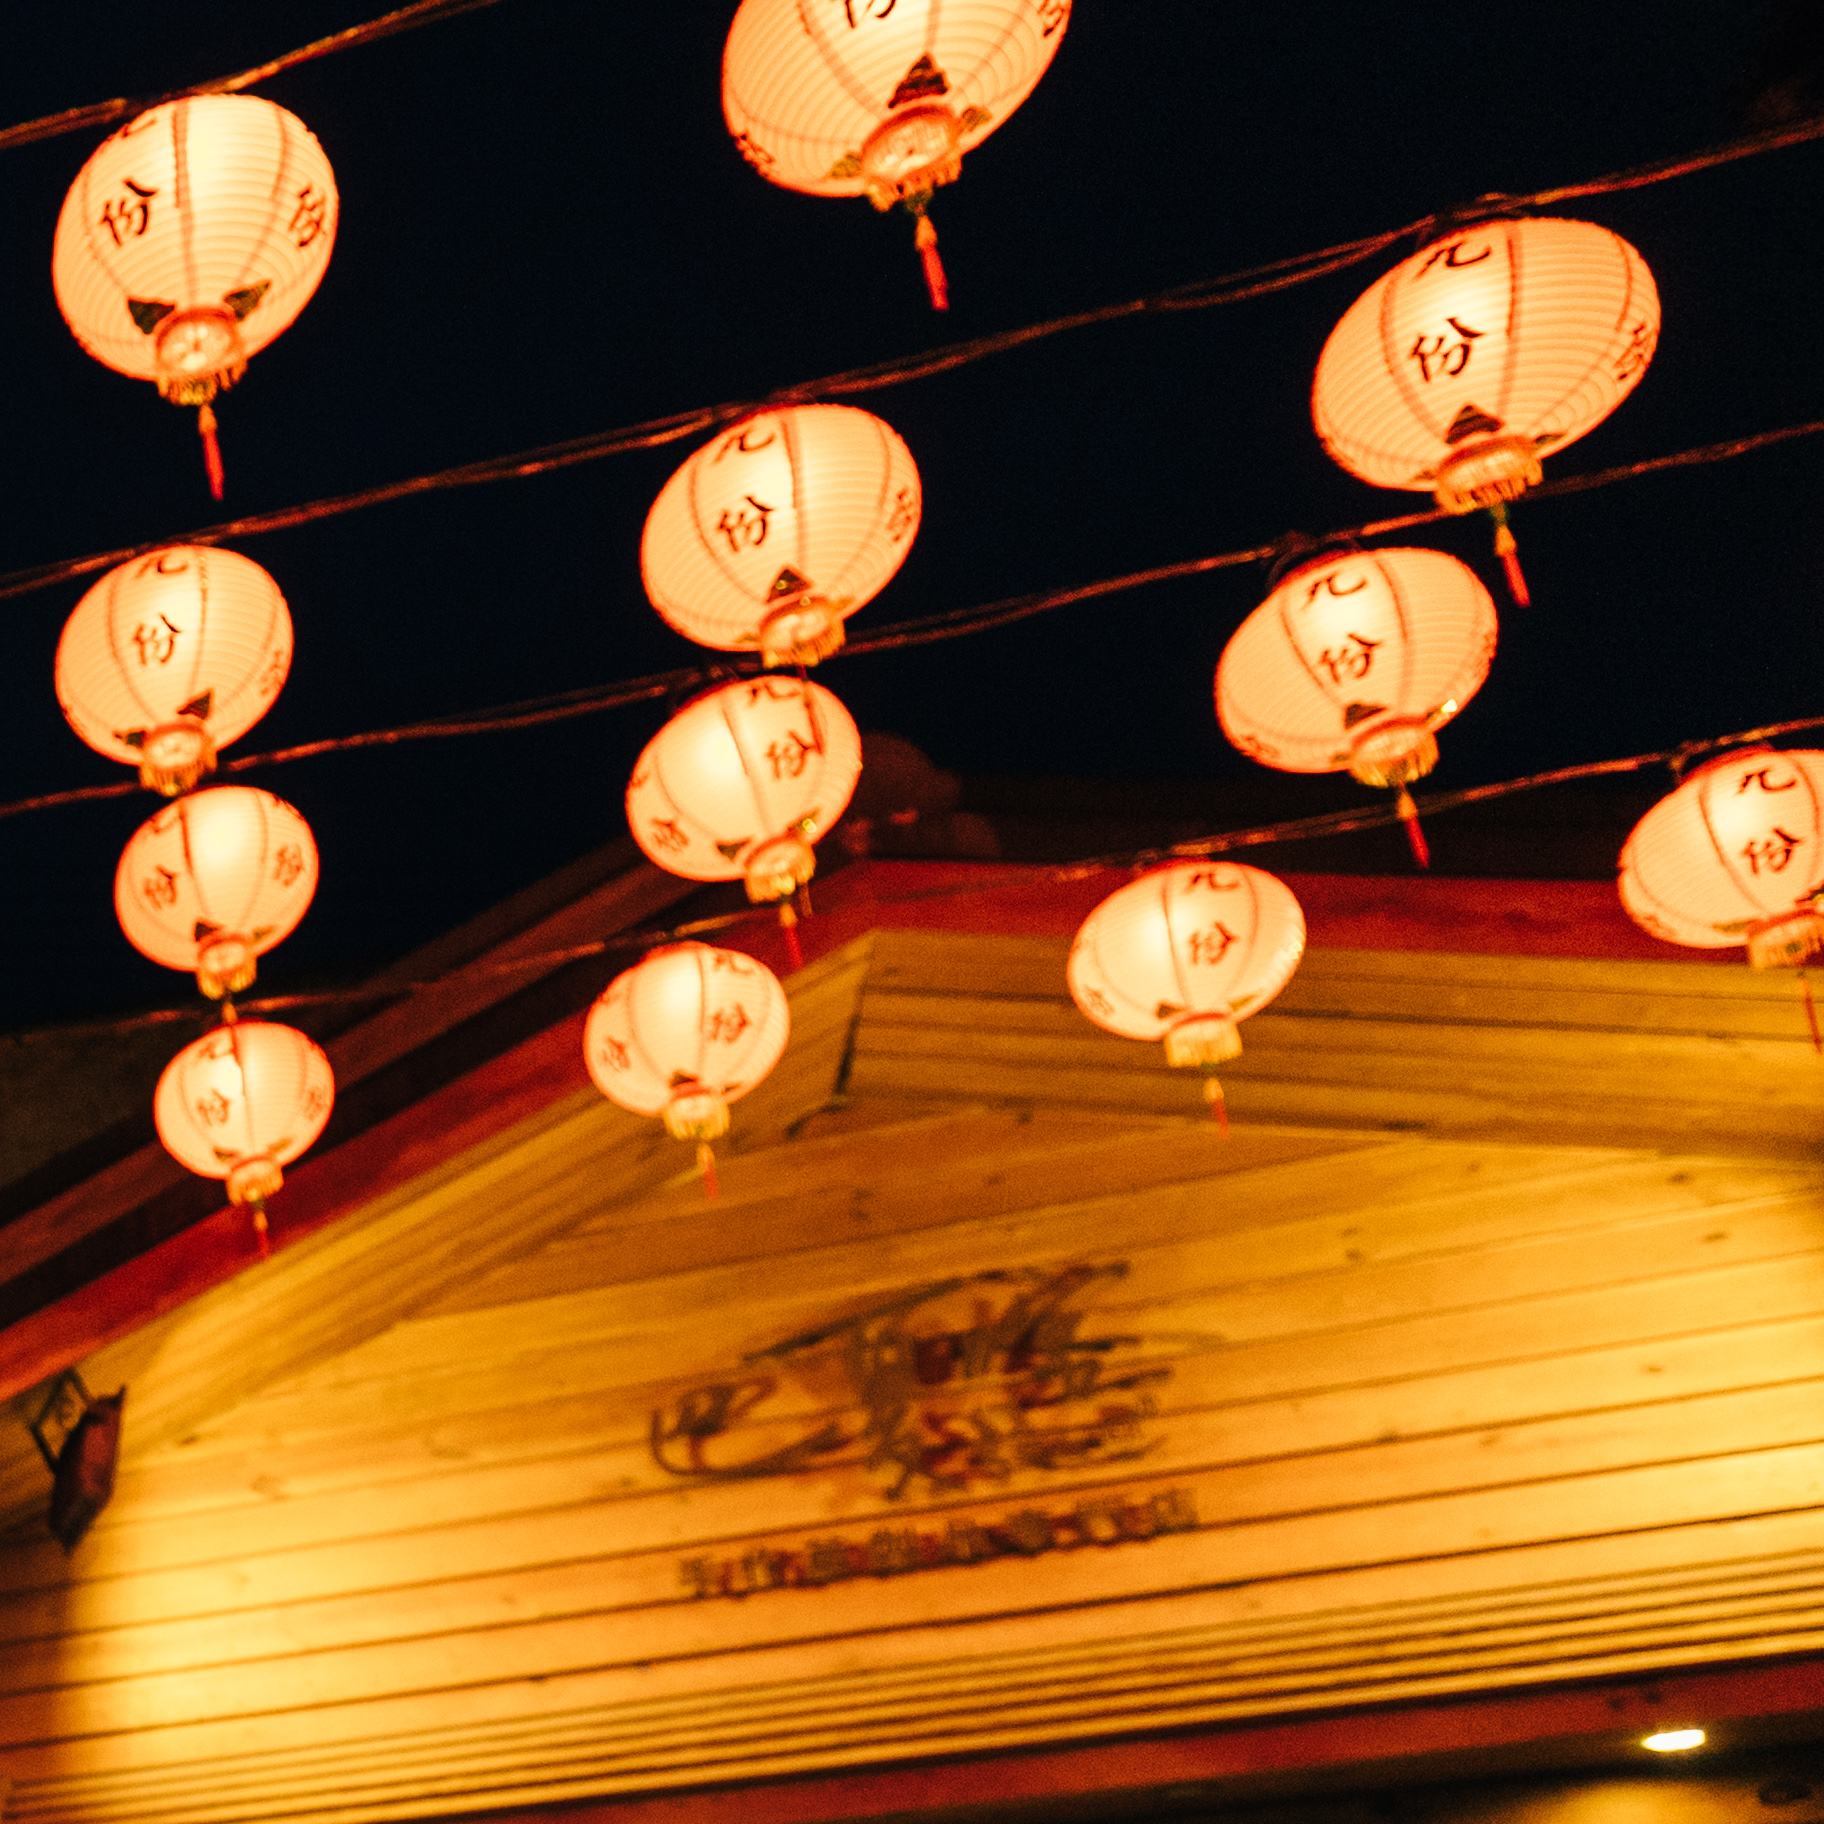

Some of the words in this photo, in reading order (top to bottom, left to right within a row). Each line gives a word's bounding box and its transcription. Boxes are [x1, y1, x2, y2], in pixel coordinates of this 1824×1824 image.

[1408, 239, 1491, 385] 九份
[1296, 572, 1383, 687] 九份
[1734, 768, 1805, 878] 九份
